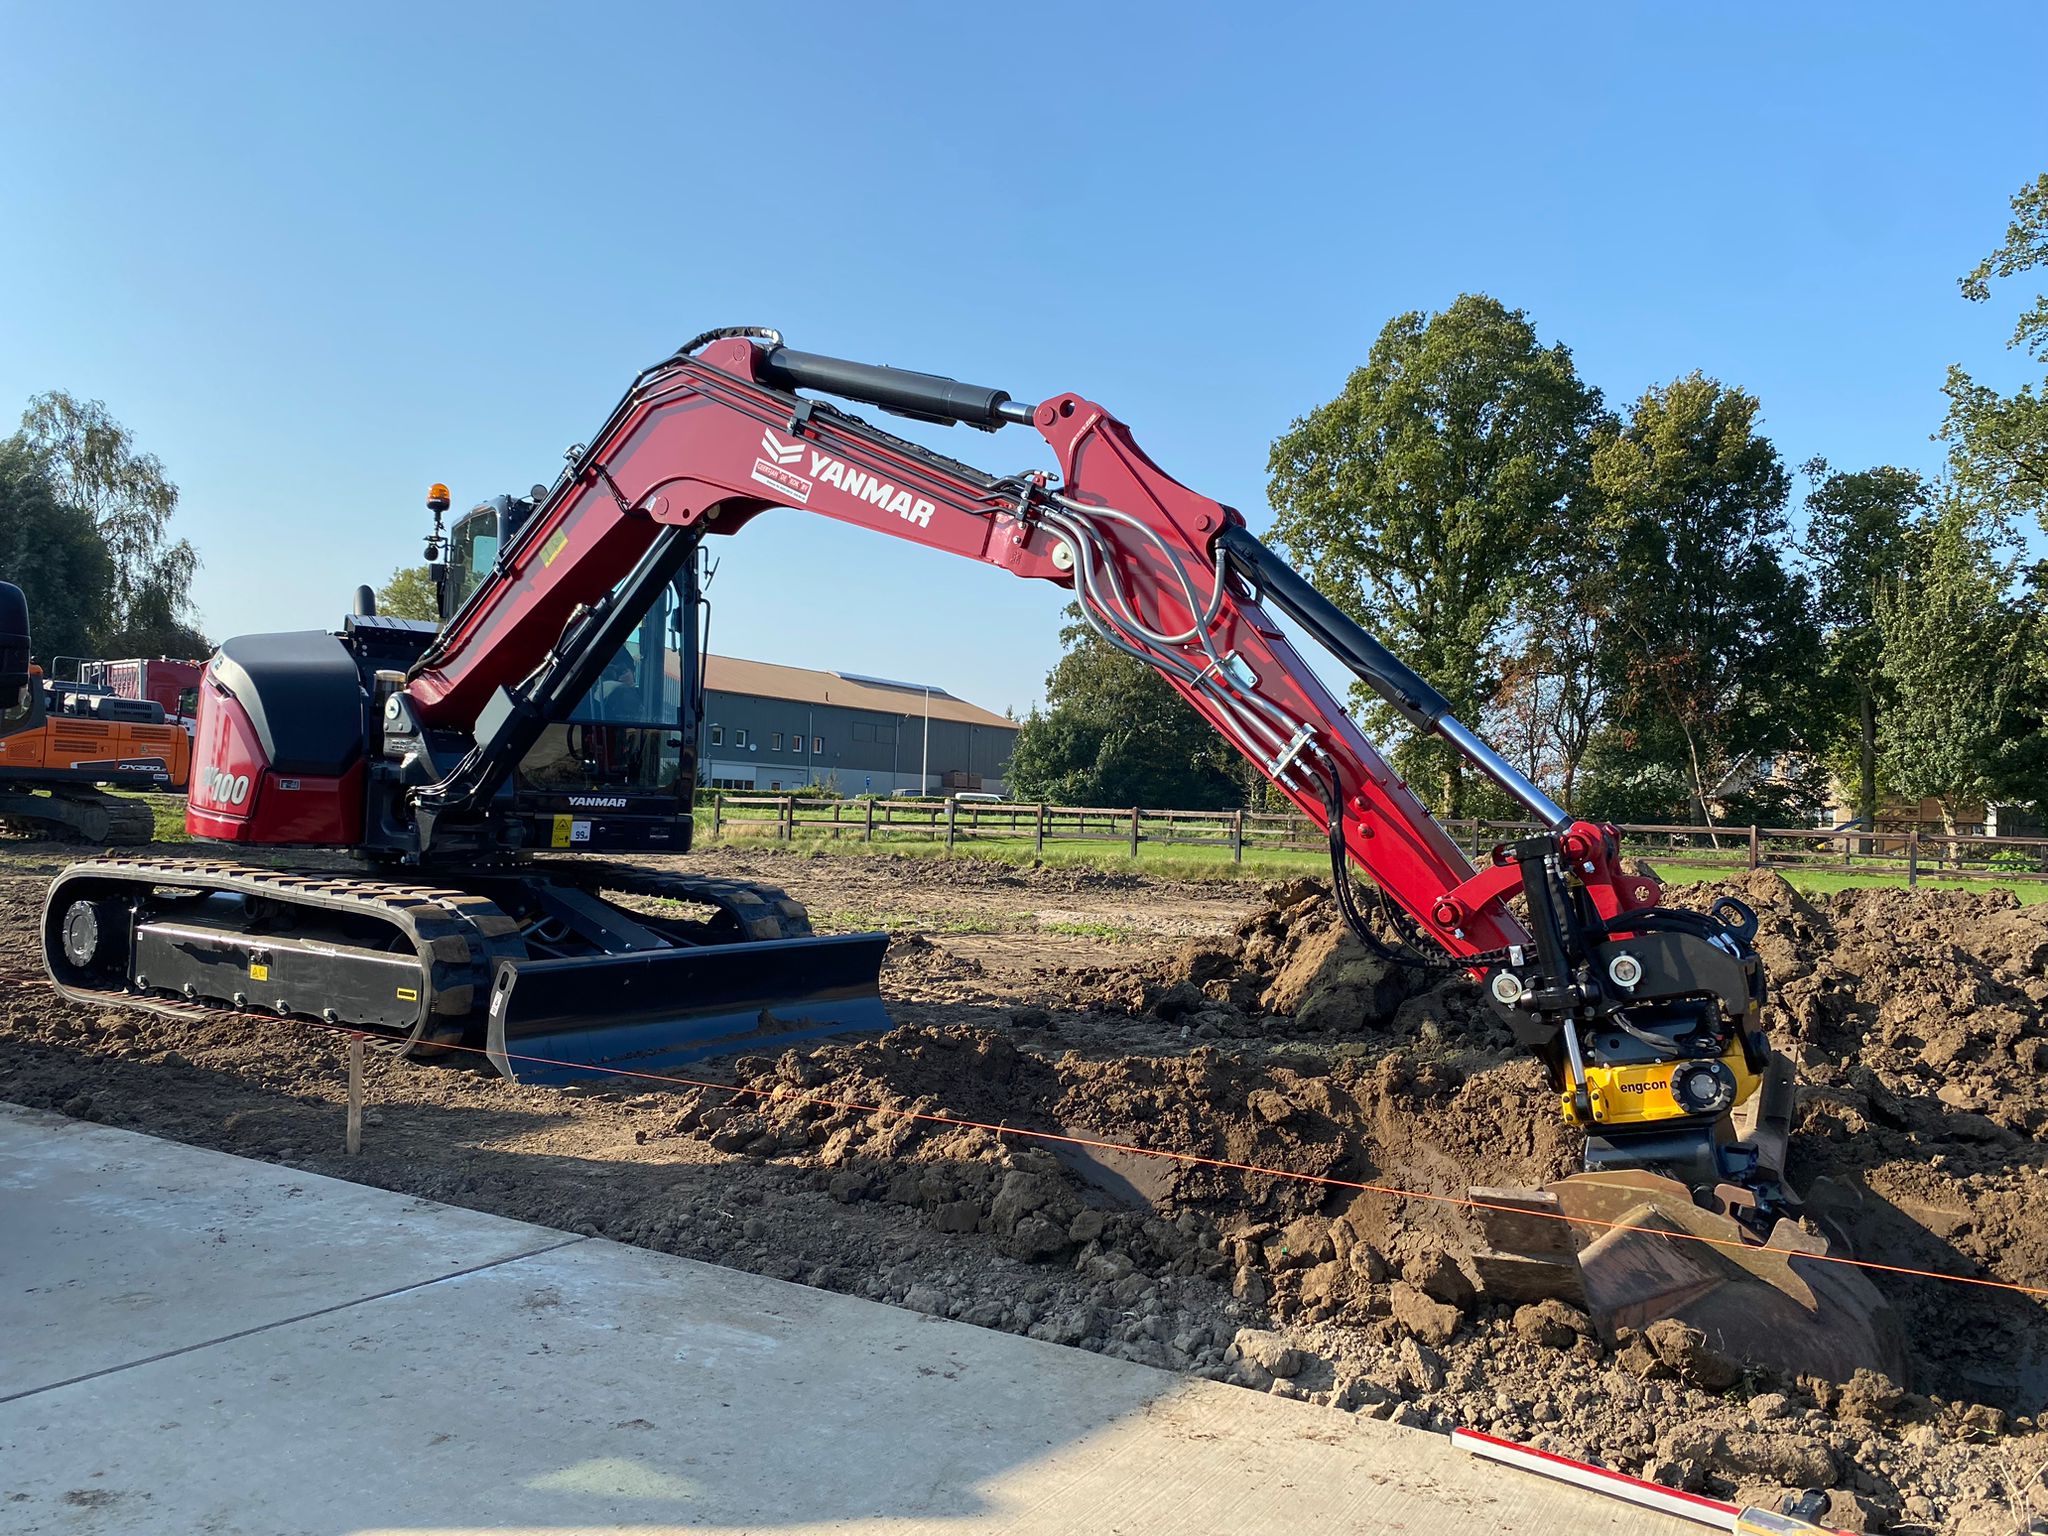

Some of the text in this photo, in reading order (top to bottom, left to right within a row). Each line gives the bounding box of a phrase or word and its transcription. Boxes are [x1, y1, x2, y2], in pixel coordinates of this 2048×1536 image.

[809, 450, 936, 529] YANMAR
[568, 797, 627, 807] YANMAR
[1620, 1080, 1667, 1095] engcon
